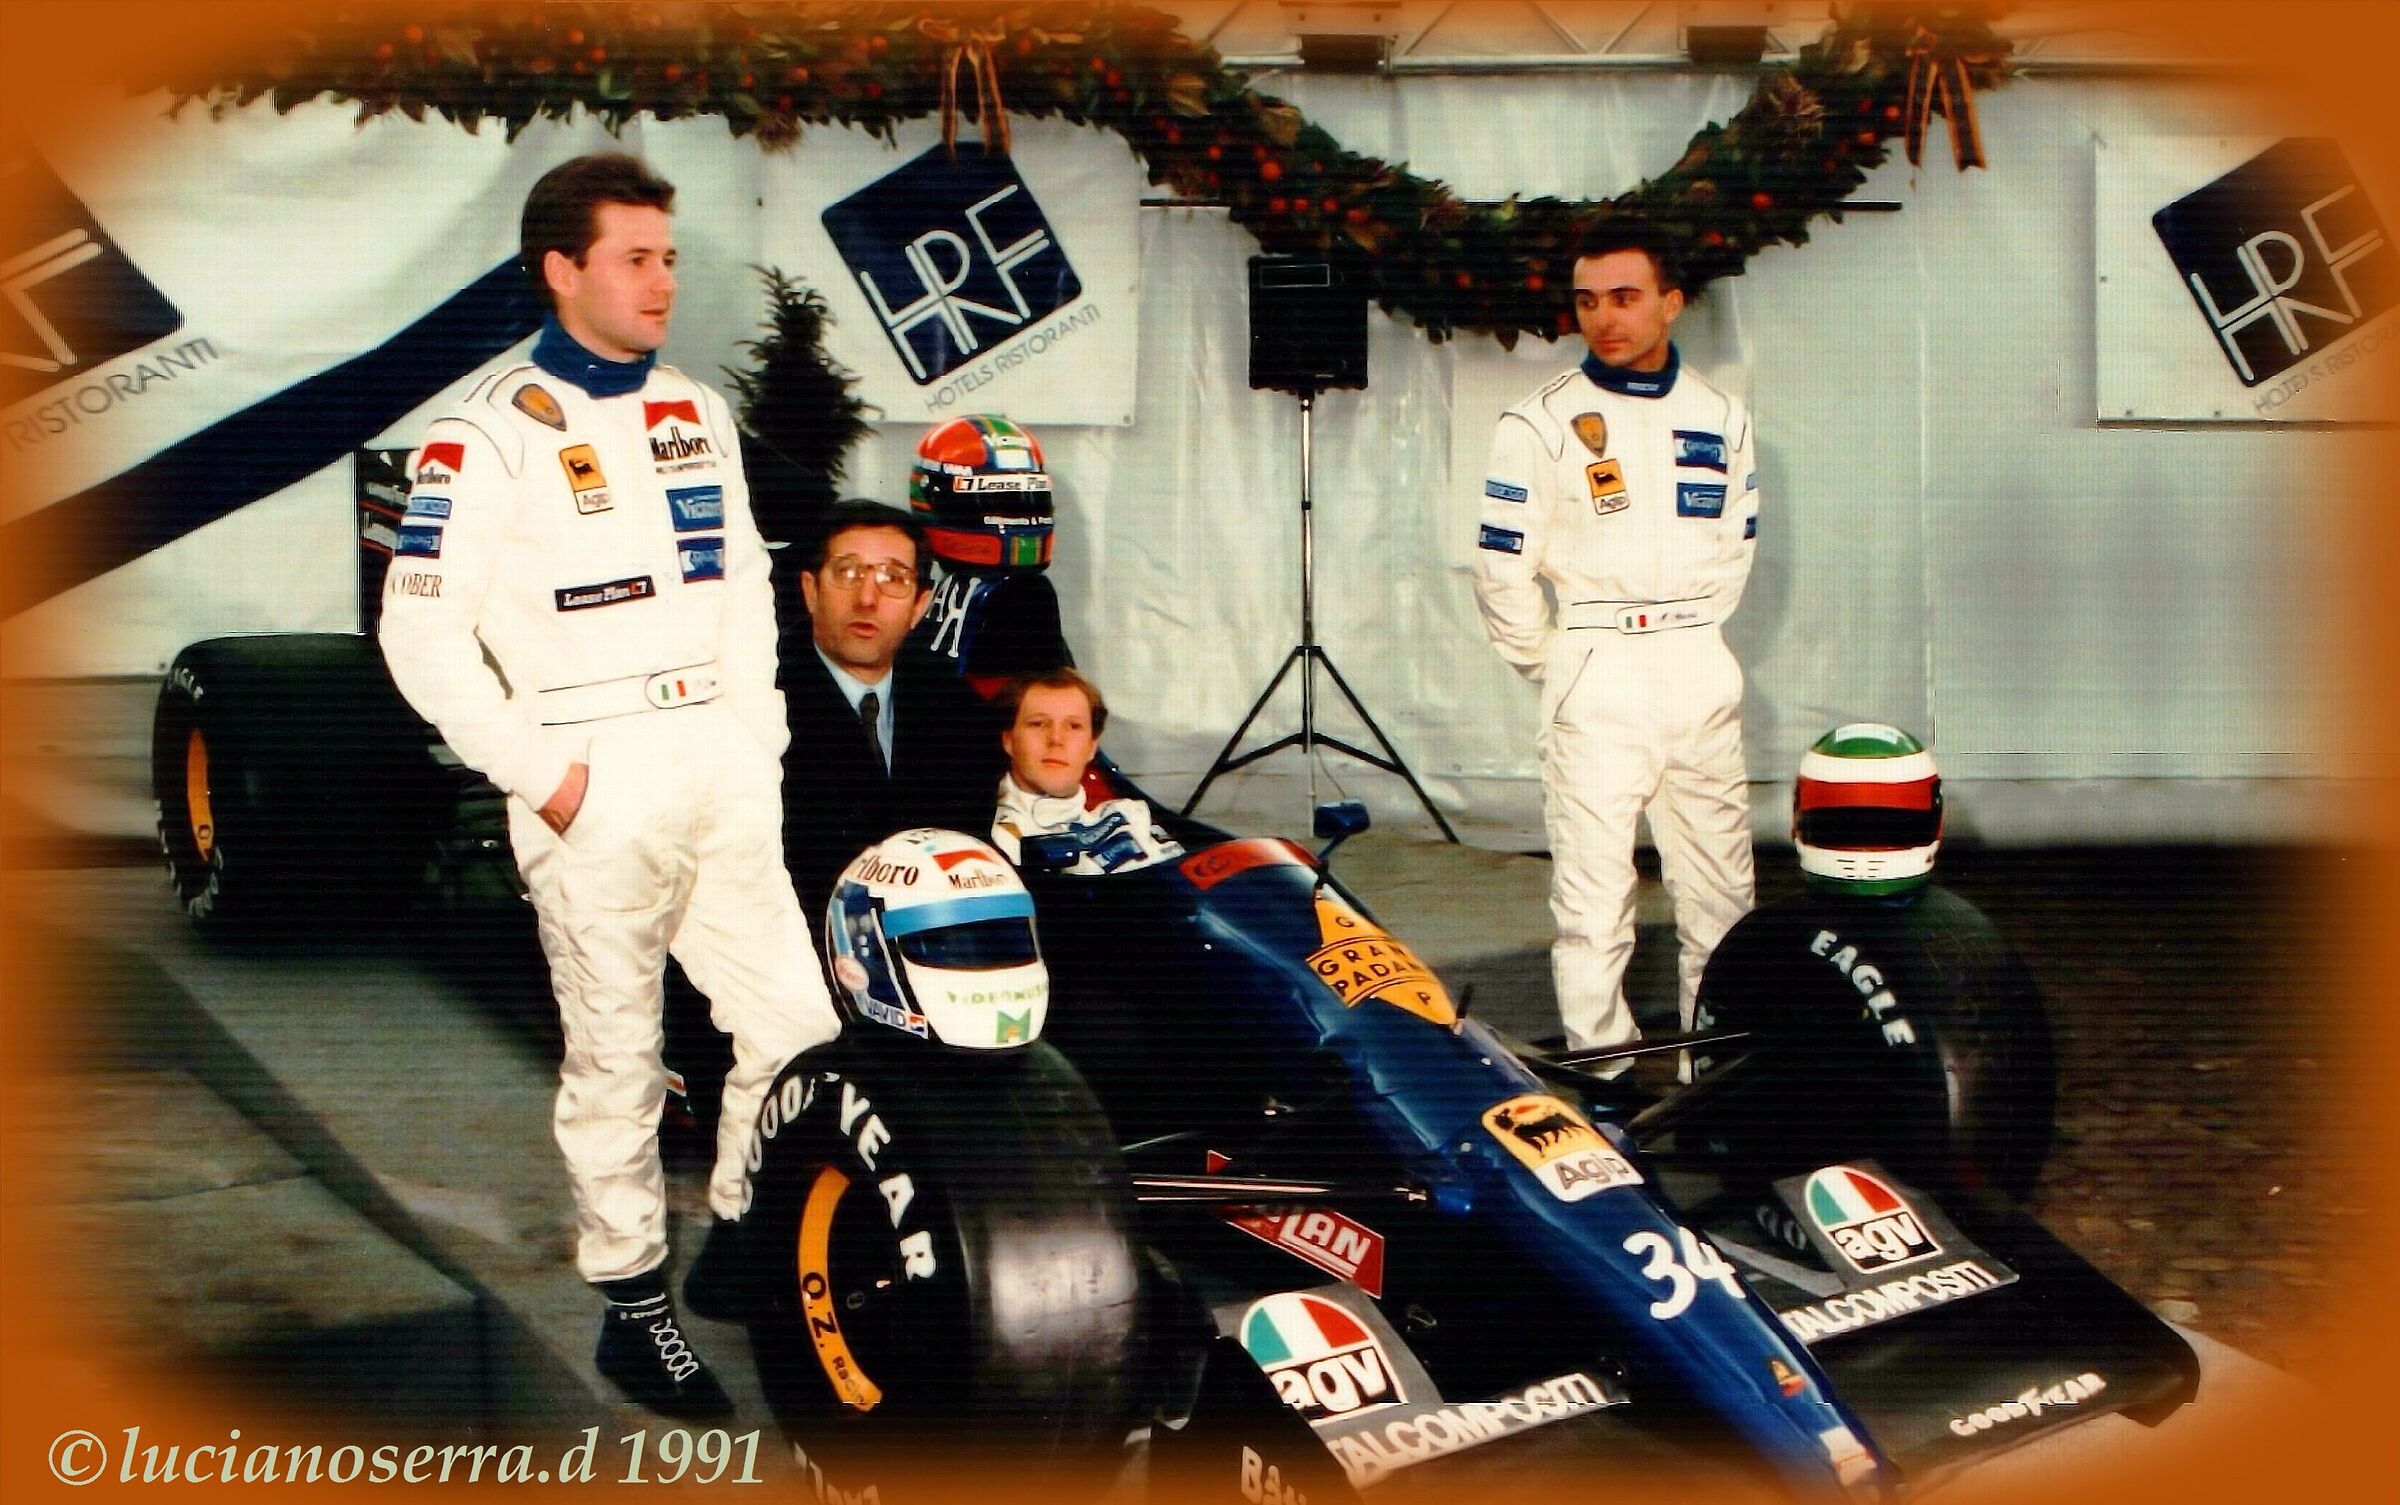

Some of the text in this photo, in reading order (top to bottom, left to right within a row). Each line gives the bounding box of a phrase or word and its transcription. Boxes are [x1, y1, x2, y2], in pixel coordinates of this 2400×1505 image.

[860, 184, 1050, 380] HRF
[2191, 184, 2385, 381] HRF
[5, 336, 220, 451] RISTORANTI
[925, 303, 1101, 413] HOTELS RISTORANTI
[649, 426, 712, 462] Marlbor
[1811, 929, 1916, 1047] EAGLE
[1622, 1225, 1747, 1321] 34
[1831, 1210, 1926, 1262] agv
[1778, 1260, 2000, 1342] TALCOMPOSITI
[1326, 1373, 1608, 1486] TALCOMPOSITI
[1949, 1372, 2107, 1437] GOODYEAR
